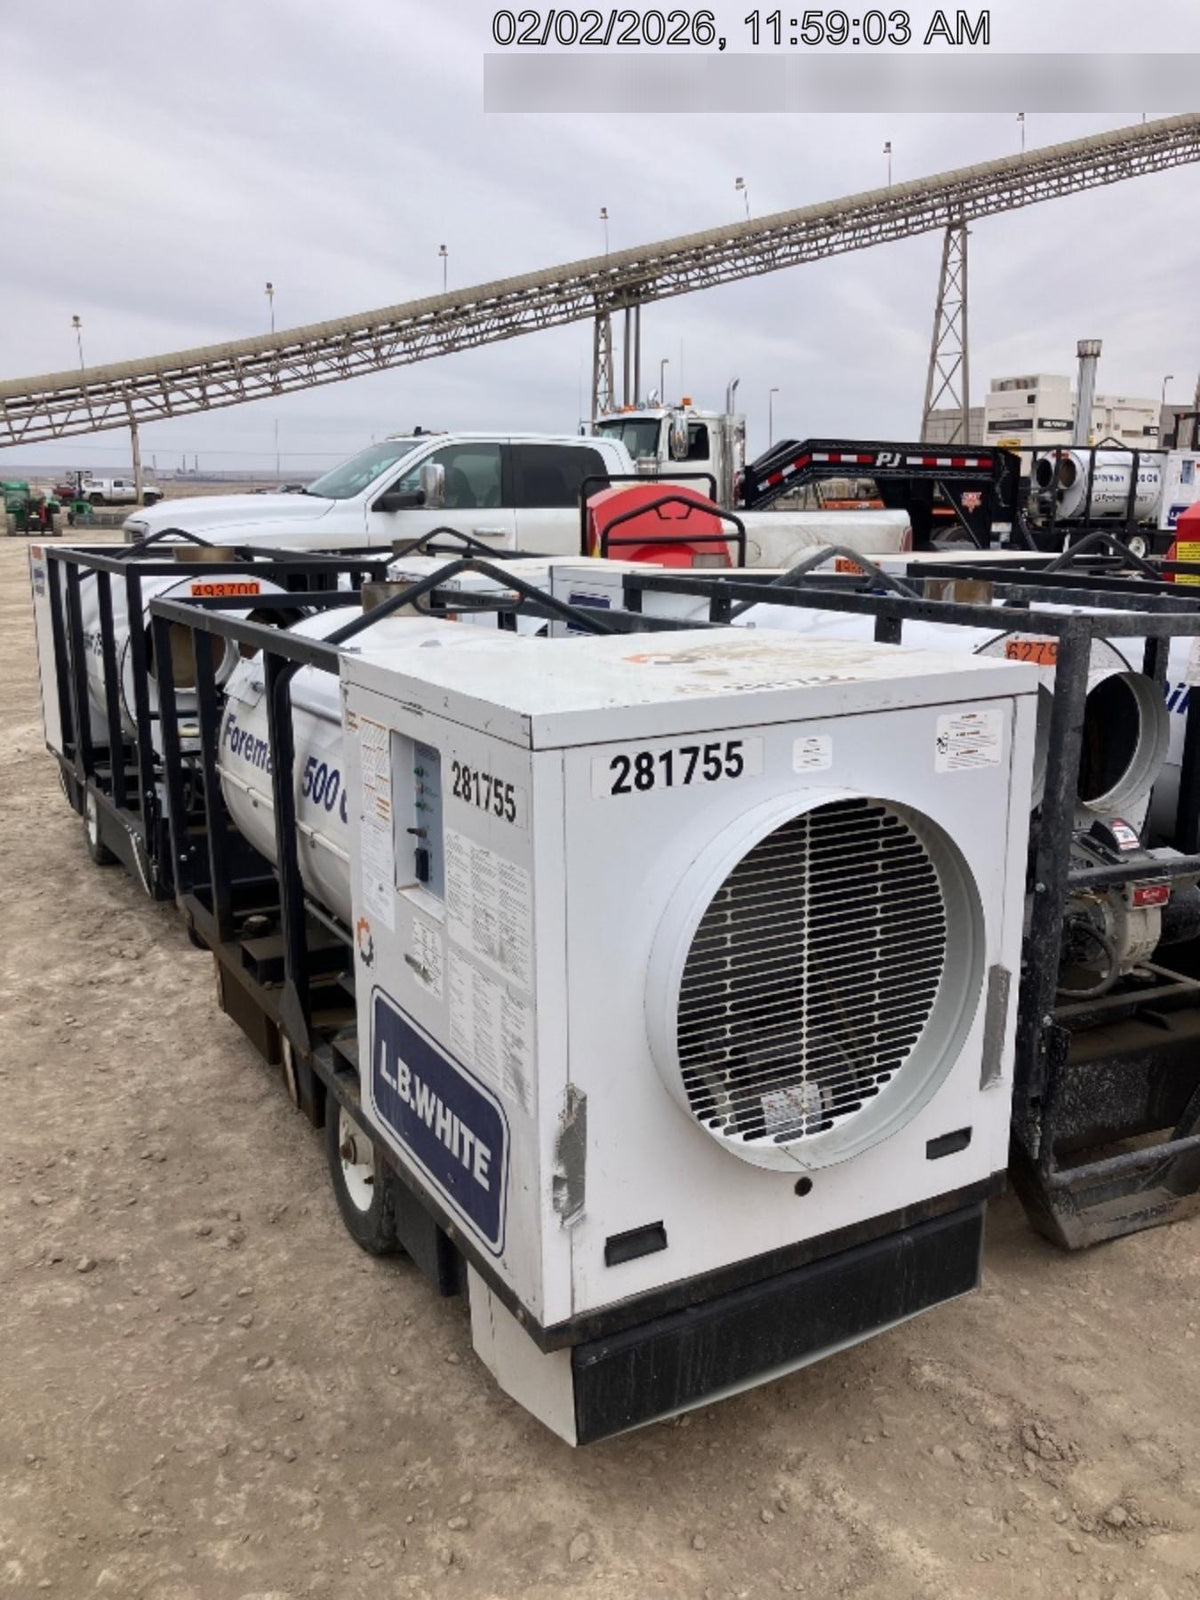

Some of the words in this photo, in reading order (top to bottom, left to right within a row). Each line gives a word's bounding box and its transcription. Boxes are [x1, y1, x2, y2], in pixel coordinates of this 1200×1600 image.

[875, 452, 902, 467] PJ
[302, 755, 340, 812] 500
[453, 762, 515, 822] 281755
[610, 740, 744, 795] 281755
